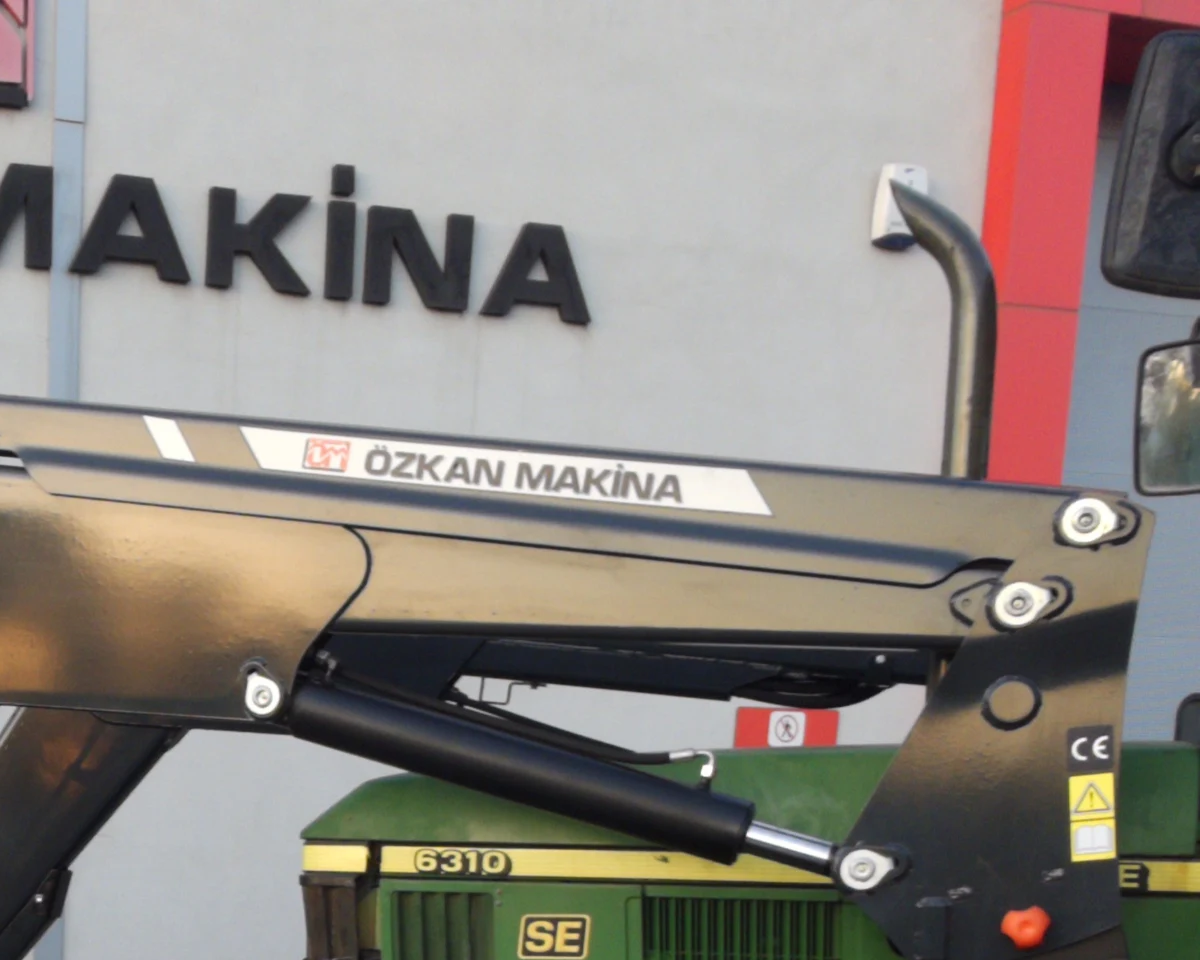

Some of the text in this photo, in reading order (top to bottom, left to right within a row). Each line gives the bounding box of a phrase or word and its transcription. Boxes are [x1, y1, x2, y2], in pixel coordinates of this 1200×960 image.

[364, 444, 683, 503] ÖZKAN MAKİNA
[1071, 735, 1109, 761] CE
[414, 848, 511, 876] 6310
[524, 919, 584, 954] SE
